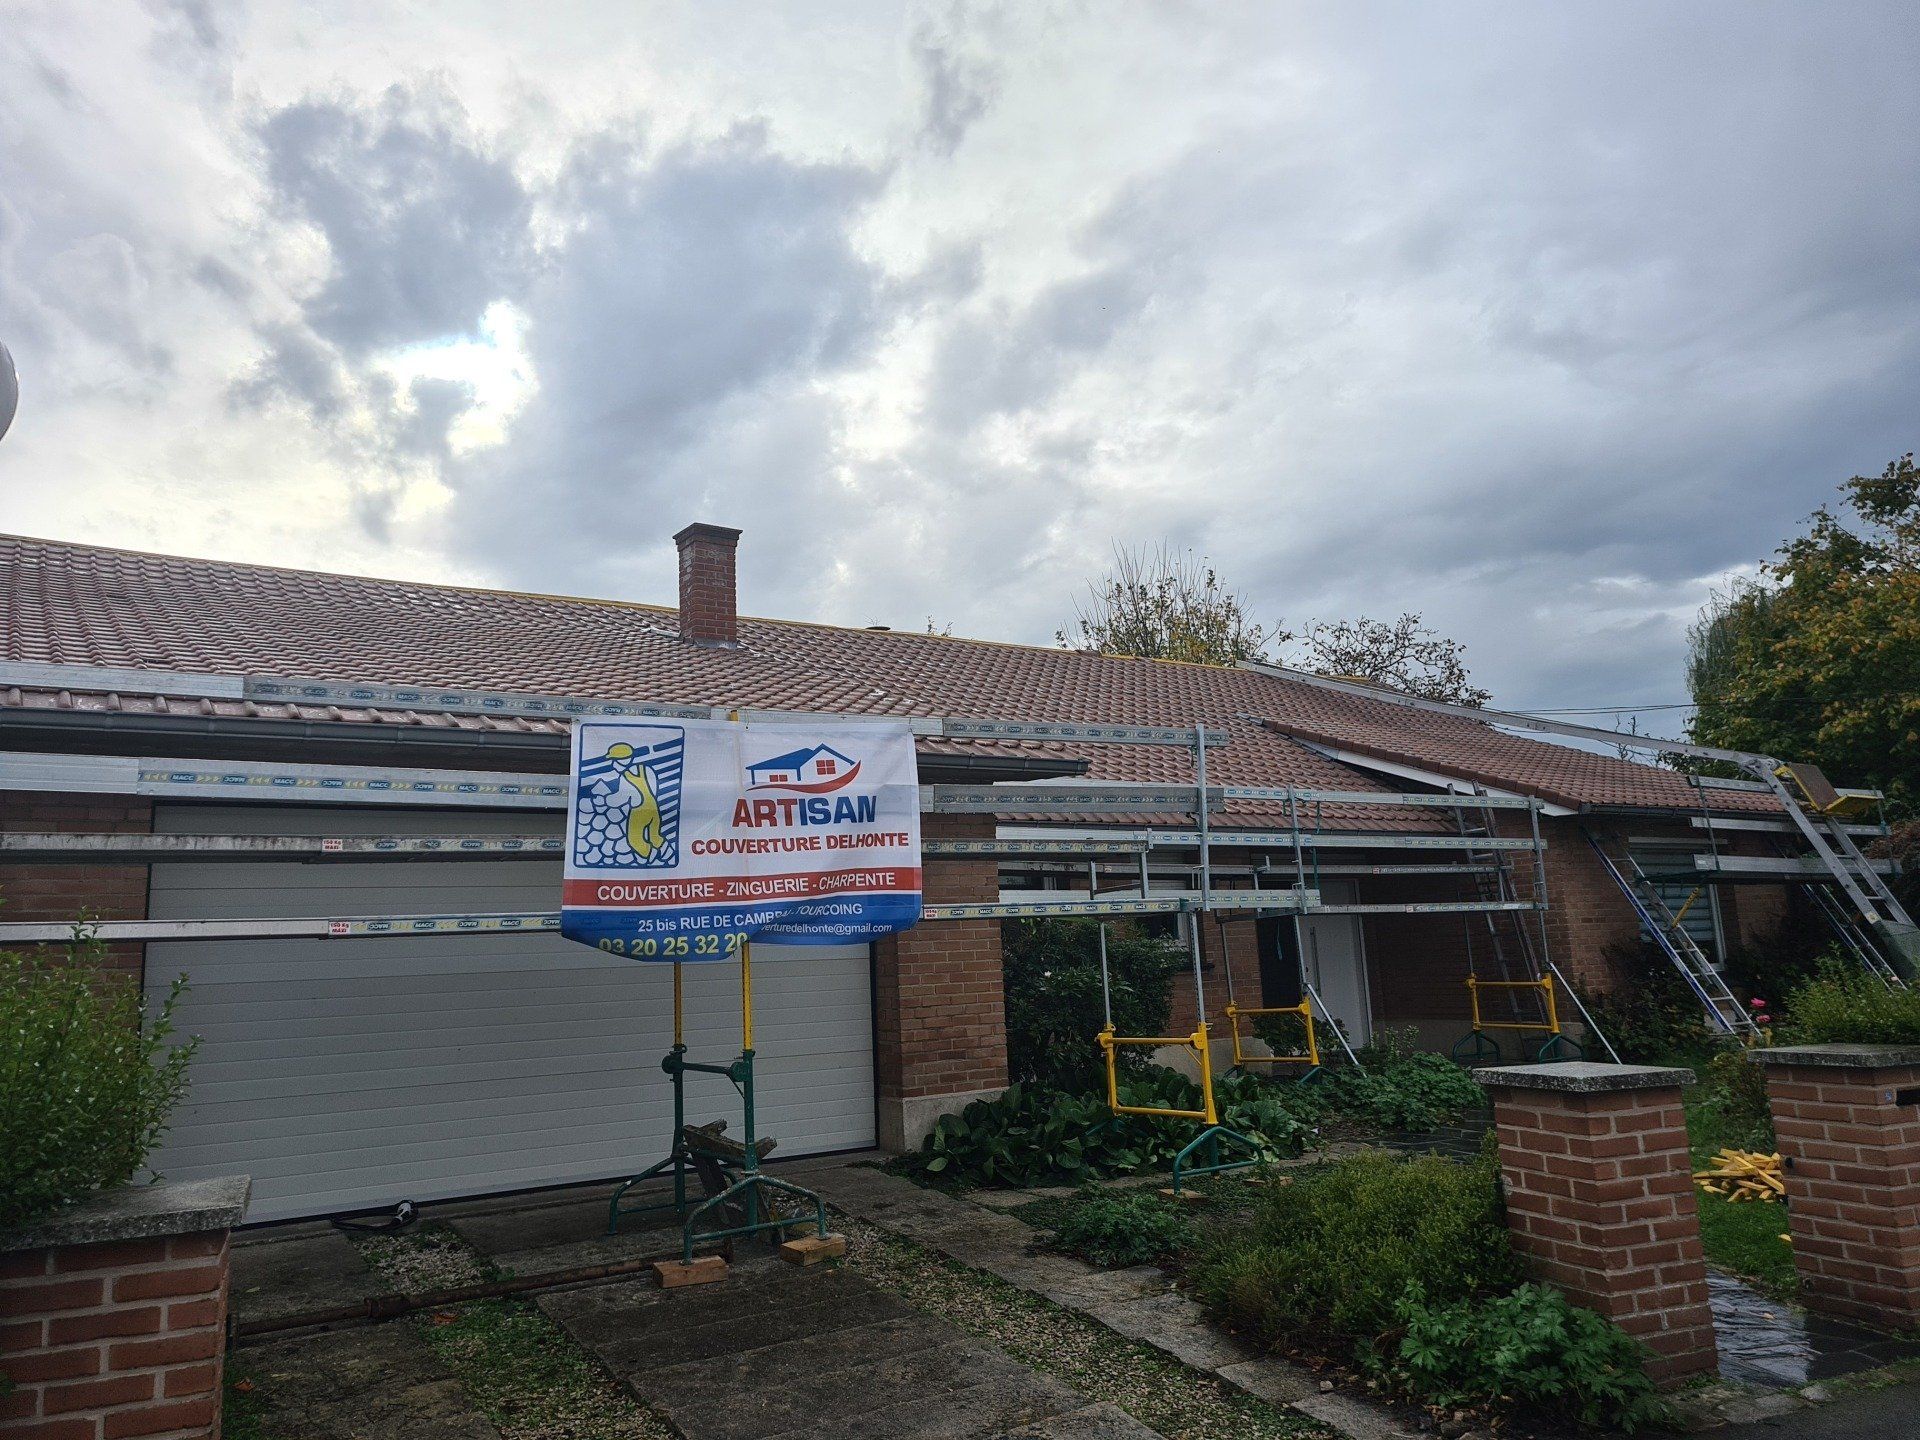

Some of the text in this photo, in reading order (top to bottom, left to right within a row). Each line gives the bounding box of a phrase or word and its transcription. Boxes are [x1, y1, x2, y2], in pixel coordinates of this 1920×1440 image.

[172, 774, 194, 782] MACC
[732, 795, 877, 828] ARTISAN
[691, 832, 909, 855] COUVERTURE DELHONTE
[597, 882, 715, 901] COUVERTURE
[726, 877, 810, 896] ZINGUERIE
[819, 872, 896, 891] CHARPENTE
[501, 919, 521, 927] MACC
[637, 919, 653, 932] 25
[656, 918, 677, 932] bis
[680, 915, 710, 930] RUE
[713, 914, 731, 927] DE
[599, 938, 625, 953] 03
[630, 938, 657, 956] 20
[662, 936, 689, 956] 25
[694, 934, 719, 954] 32
